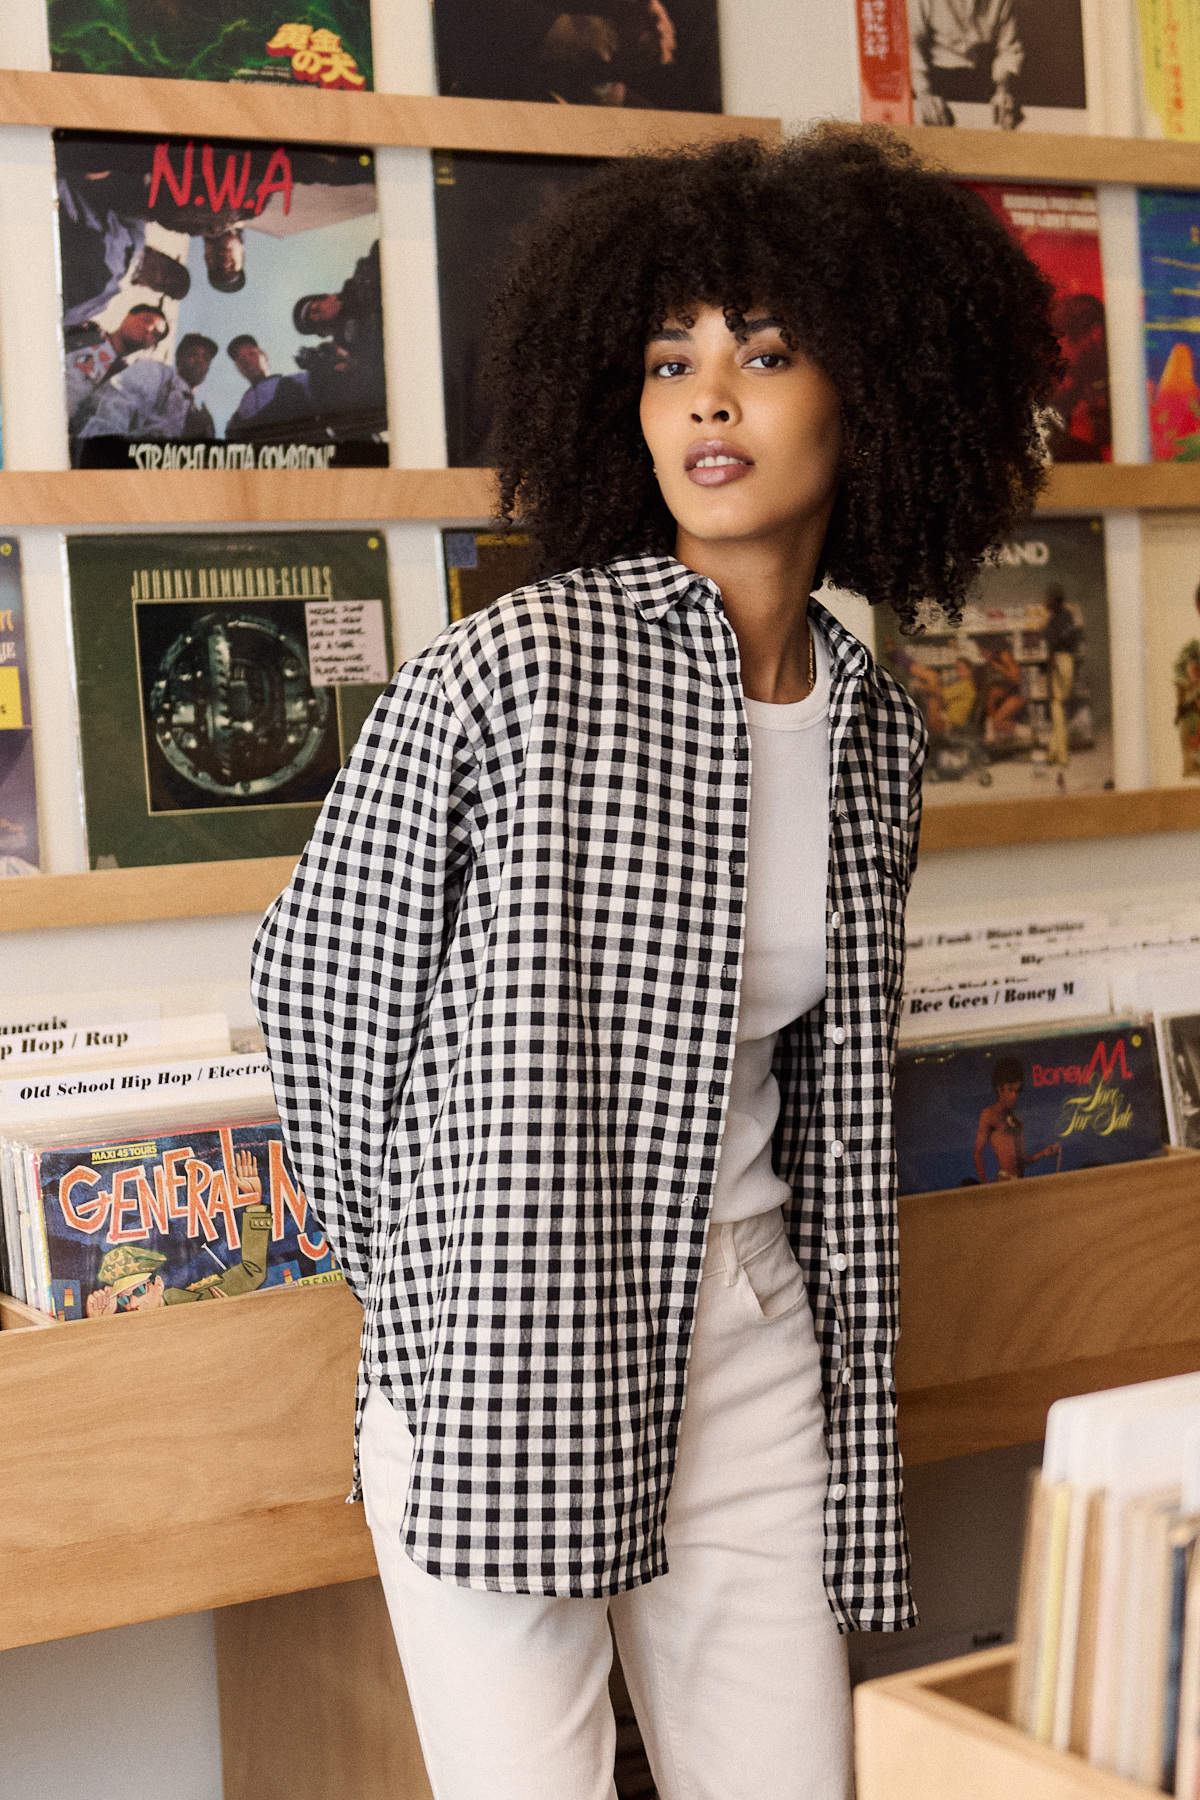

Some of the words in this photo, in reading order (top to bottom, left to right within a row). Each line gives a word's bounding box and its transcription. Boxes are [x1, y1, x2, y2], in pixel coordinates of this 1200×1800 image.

[148, 140, 293, 216] N.W.A
[910, 998, 943, 1014] Bee
[948, 993, 989, 1009] Gees
[1004, 987, 1057, 1004] Boney
[22, 1038, 64, 1054] Hop
[86, 1031, 128, 1048] Rap
[20, 1085, 51, 1100] Old
[57, 1078, 115, 1096] School
[121, 1075, 151, 1090] Hip
[157, 1072, 192, 1086] Hop
[208, 1064, 270, 1079] Electro
[91, 1150, 117, 1161] MAXI
[117, 1148, 129, 1157] 45
[129, 1145, 158, 1156] TOURS
[59, 1127, 261, 1251] GENERAL
